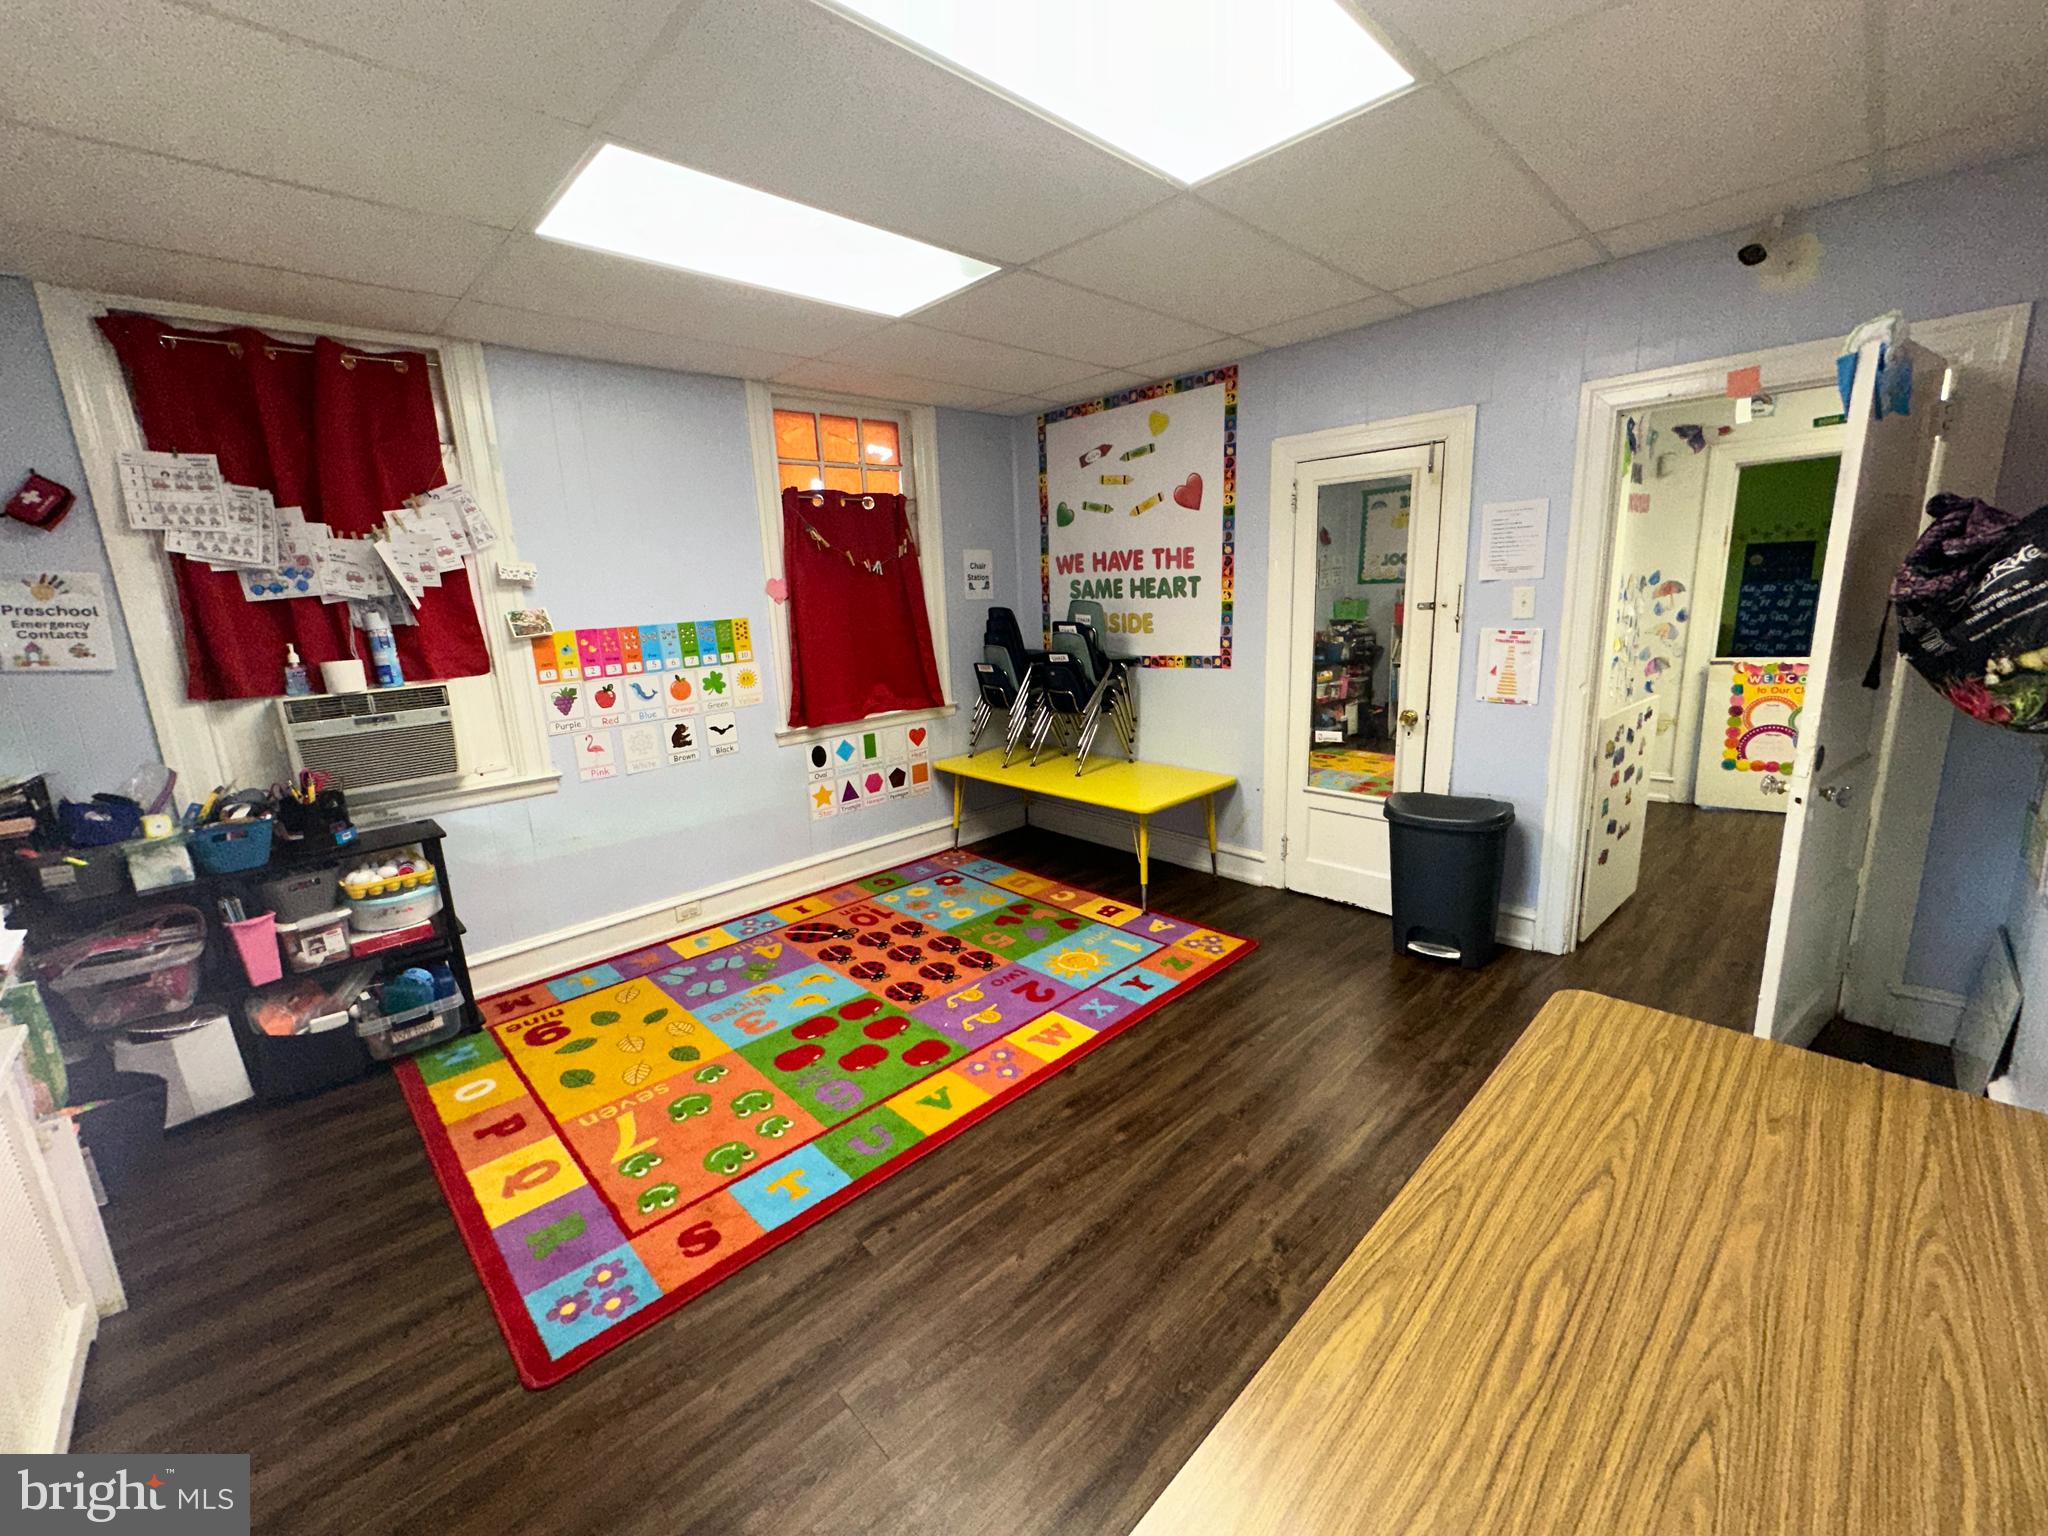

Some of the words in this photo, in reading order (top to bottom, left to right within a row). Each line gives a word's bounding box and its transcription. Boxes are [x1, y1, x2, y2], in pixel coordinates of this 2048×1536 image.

[969, 562, 986, 570] Chair
[1055, 553, 1085, 576] WE
[1092, 549, 1144, 573] HAVE
[1152, 546, 1195, 570] THE
[967, 573, 989, 581] Station
[2013, 580, 2030, 591] we
[1069, 577, 1123, 599] SAME
[1129, 575, 1201, 599] HEART
[1, 604, 99, 617] Preschool
[1965, 608, 1989, 625] make
[10, 620, 90, 631] Emergency
[1103, 612, 1154, 634] SIDE
[16, 630, 88, 639] Contacts
[1748, 673, 1808, 684] WELCO
[1757, 686, 1767, 694] to
[1771, 686, 1790, 694] Our
[672, 706, 695, 715] Orange
[707, 702, 729, 710] Green
[602, 716, 620, 725] Red
[638, 711, 657, 720] Blue
[555, 721, 582, 731] Purple
[673, 753, 696, 762] Brown
[716, 746, 735, 755] Black
[590, 768, 610, 777] Pink
[814, 772, 828, 780] Oval
[1050, 891, 1076, 901] C
[793, 905, 811, 914] I
[849, 908, 895, 926] 10
[1097, 904, 1125, 918] B
[1148, 919, 1176, 933] A
[1111, 939, 1142, 952] 1
[1160, 956, 1193, 971] Z
[990, 968, 1029, 987] two
[1120, 975, 1155, 992] Y
[1011, 980, 1056, 1003] 2
[494, 994, 535, 1014] M
[1079, 998, 1119, 1018] X
[505, 1008, 564, 1033] nine
[733, 1010, 778, 1035] 3
[523, 1020, 571, 1047] 9
[1026, 1022, 1073, 1047] W
[435, 1042, 480, 1067] N
[453, 1078, 496, 1102] O
[815, 1079, 864, 1110] 6
[915, 1086, 953, 1111] V
[578, 1083, 670, 1127] seven
[473, 1112, 527, 1141] P
[609, 1110, 661, 1165] 7
[848, 1124, 893, 1155] U
[500, 1159, 561, 1199] Q
[765, 1168, 811, 1201] T
[525, 1211, 586, 1261] R
[676, 1220, 721, 1258] S
